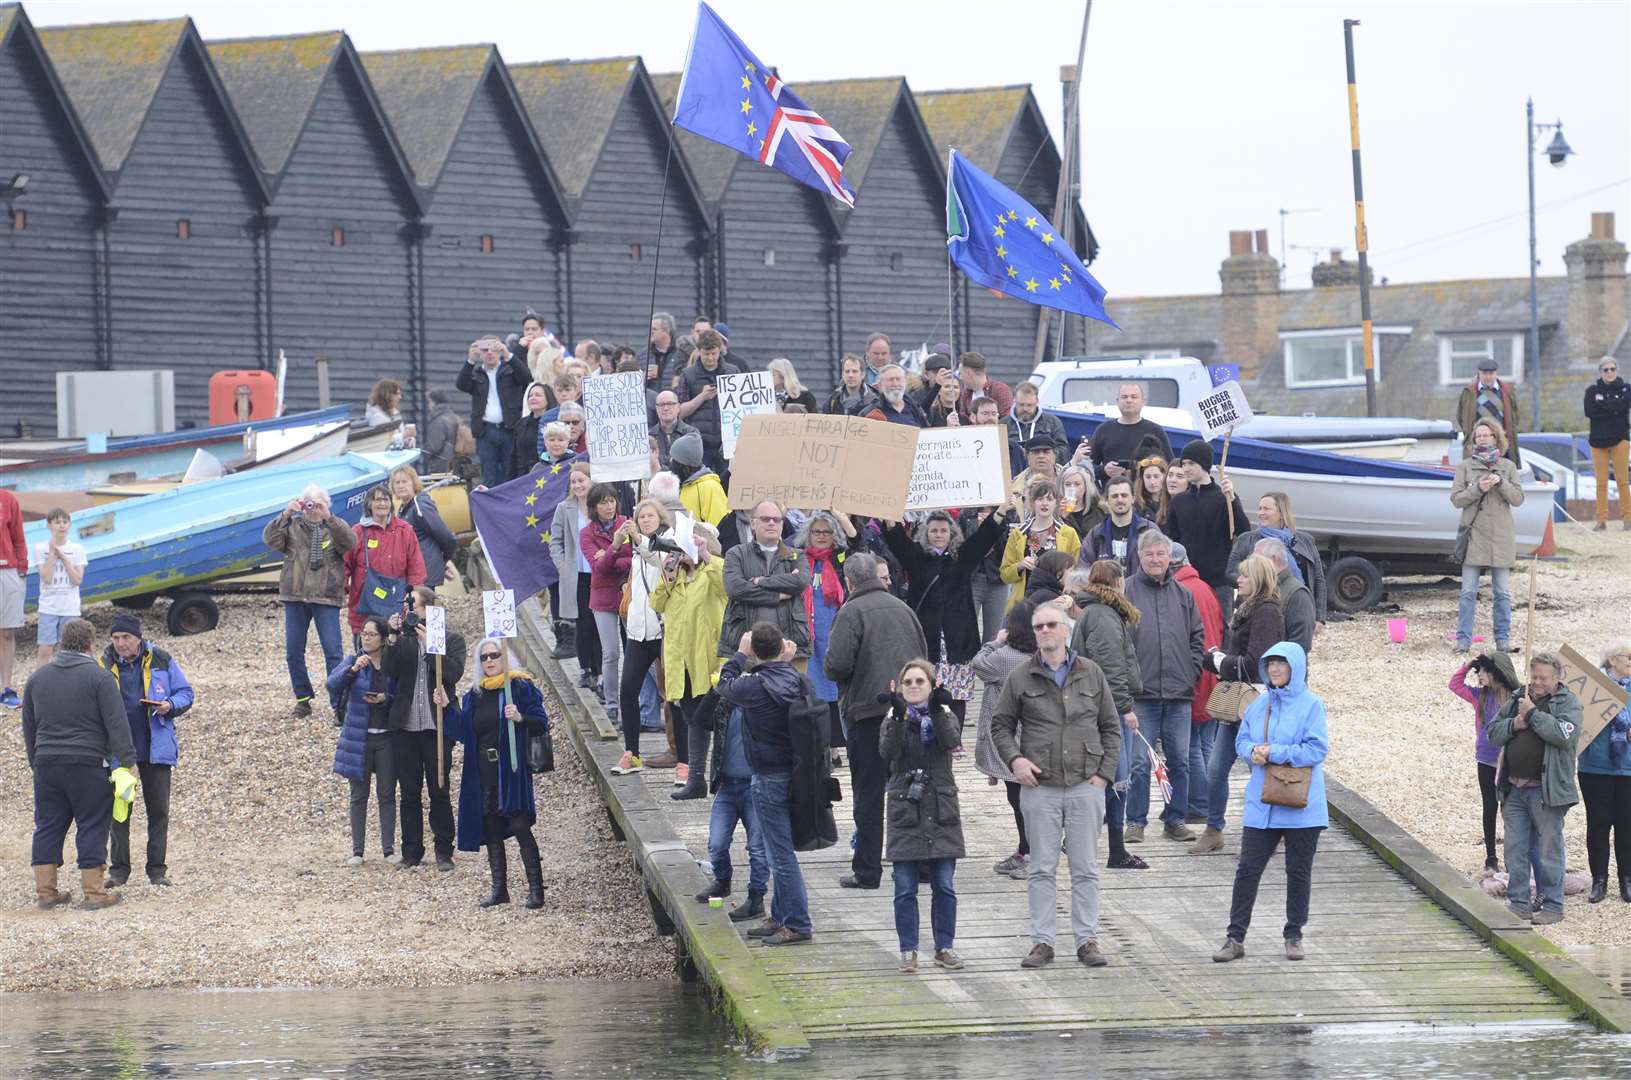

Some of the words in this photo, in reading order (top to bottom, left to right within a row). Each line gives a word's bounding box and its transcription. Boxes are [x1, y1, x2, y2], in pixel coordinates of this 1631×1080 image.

[616, 373, 643, 390] SOLD
[719, 374, 737, 394] ITS
[740, 373, 766, 392] ALL
[722, 393, 736, 410] A
[739, 388, 773, 406] CON!
[1198, 390, 1231, 411] BUGGER
[1220, 400, 1234, 412] MR
[617, 422, 648, 441] BURNT
[805, 418, 869, 438] FARAGE
[891, 429, 909, 444] IS
[619, 438, 649, 456] BOATS
[799, 441, 845, 468] NOT
[799, 466, 825, 480] THE
[908, 479, 970, 493] argantuan
